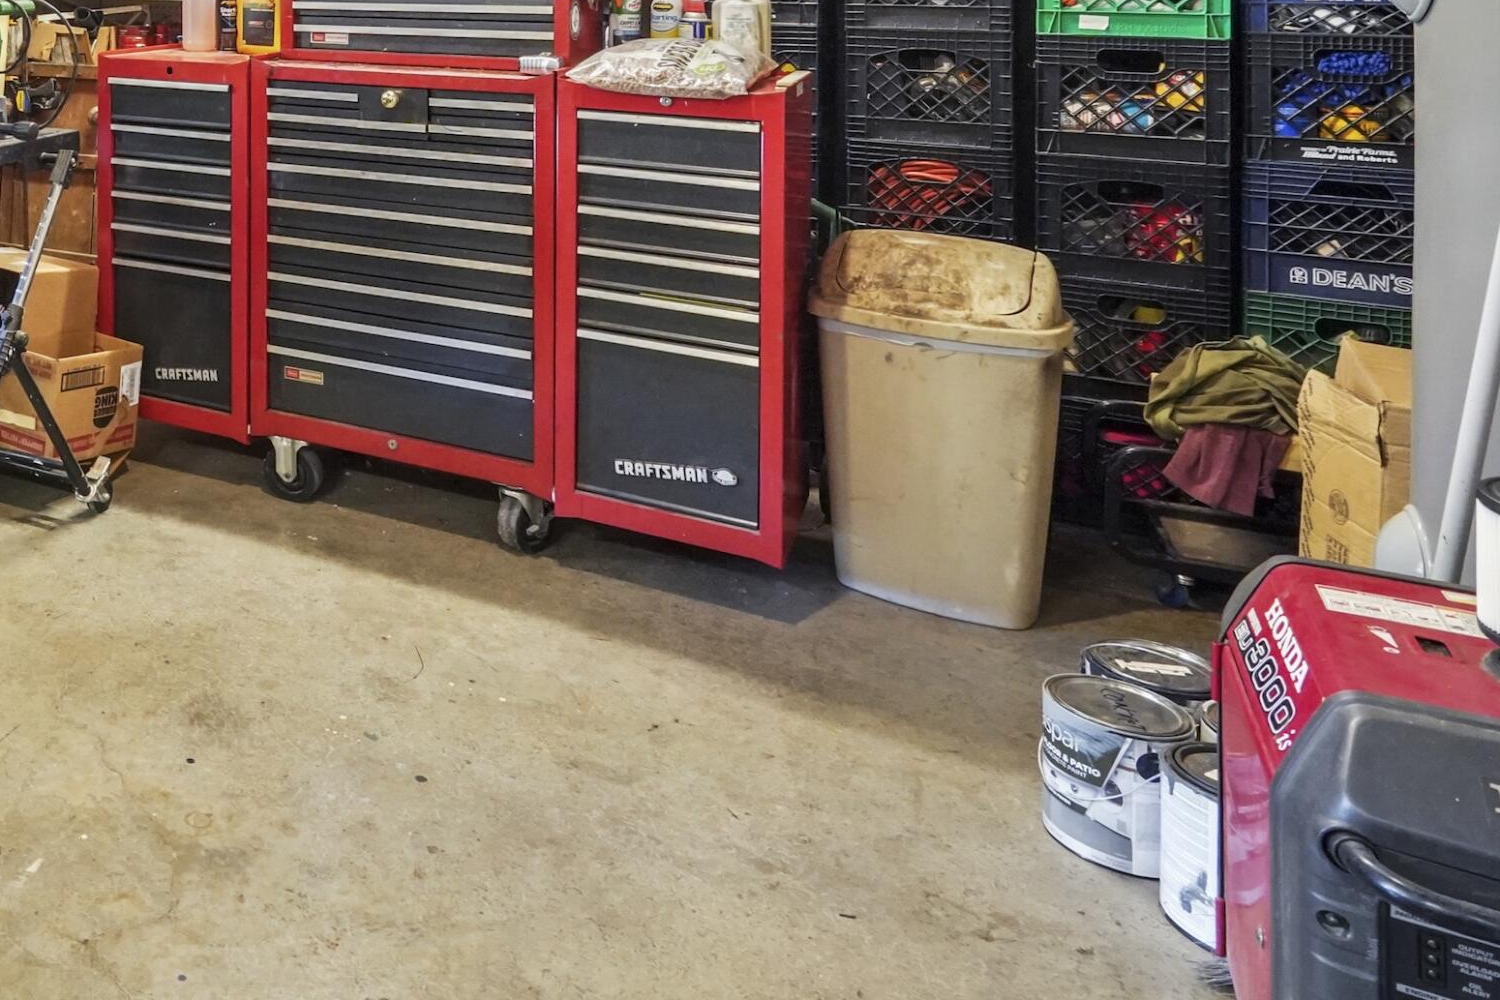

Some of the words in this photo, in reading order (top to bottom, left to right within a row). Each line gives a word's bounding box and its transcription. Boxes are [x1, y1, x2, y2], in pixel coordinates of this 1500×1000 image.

[651, 14, 678, 23] tarting
[1356, 155, 1398, 164] Roberts
[1312, 267, 1413, 295] DEAN'S
[155, 367, 219, 382] CRAFTSMAN
[614, 460, 709, 483] CRAFTSMAN
[1264, 598, 1311, 694] HONDA
[1070, 757, 1102, 778] PATIO
[1458, 943, 1494, 958] OUTPUT
[1459, 967, 1493, 981] ALARM
[1461, 985, 1491, 999] ALERT
[1468, 982, 1483, 992] OIL
